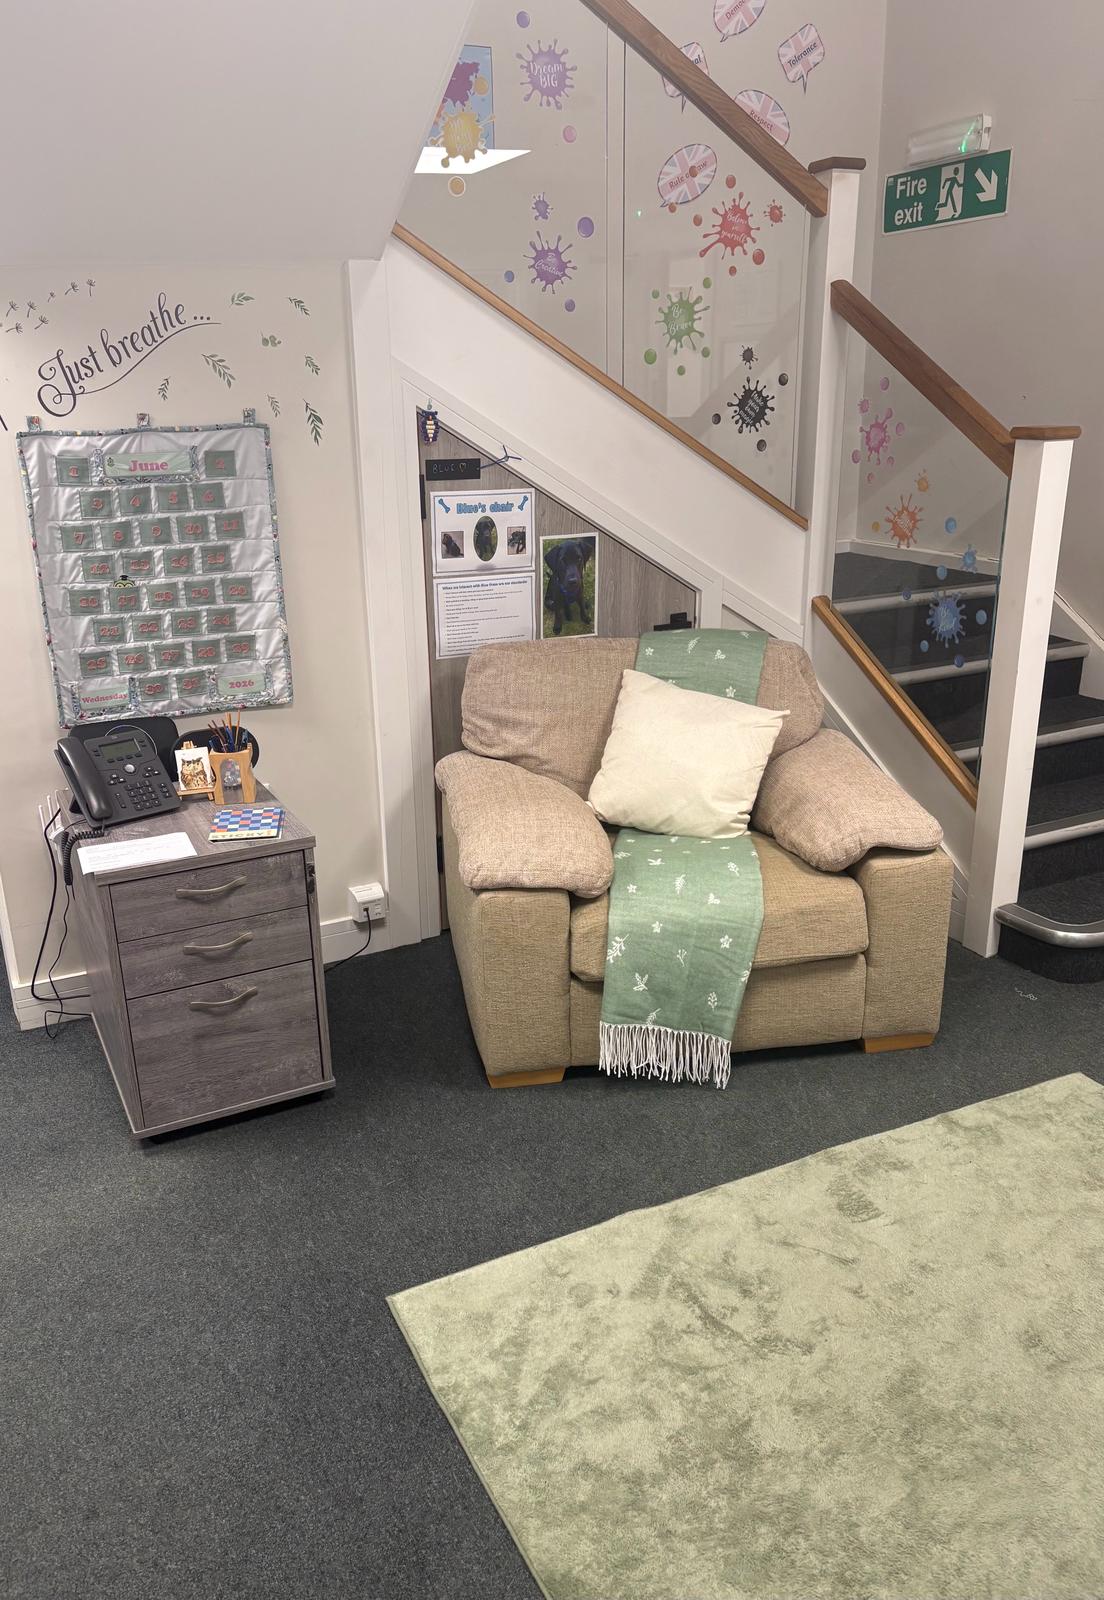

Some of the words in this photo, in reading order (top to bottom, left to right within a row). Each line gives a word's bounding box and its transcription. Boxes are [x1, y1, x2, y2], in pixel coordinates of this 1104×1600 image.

[788, 41, 818, 68] Tolerance
[529, 61, 563, 76] Dream
[540, 73, 558, 89] BIG
[750, 109, 773, 131] Respect
[669, 175, 684, 189] Rule
[896, 177, 927, 199] Fire
[894, 202, 923, 225] exit
[37, 345, 104, 418] Just
[129, 460, 169, 472] June
[433, 463, 455, 474] BLUE
[456, 502, 487, 514] Blue's
[489, 501, 515, 513] chair
[73, 531, 86, 545] 7
[86, 658, 107, 670] 25
[124, 653, 145, 665] 26
[161, 650, 180, 662] 27
[82, 692, 128, 705] Wednesday
[228, 680, 255, 689] 2026
